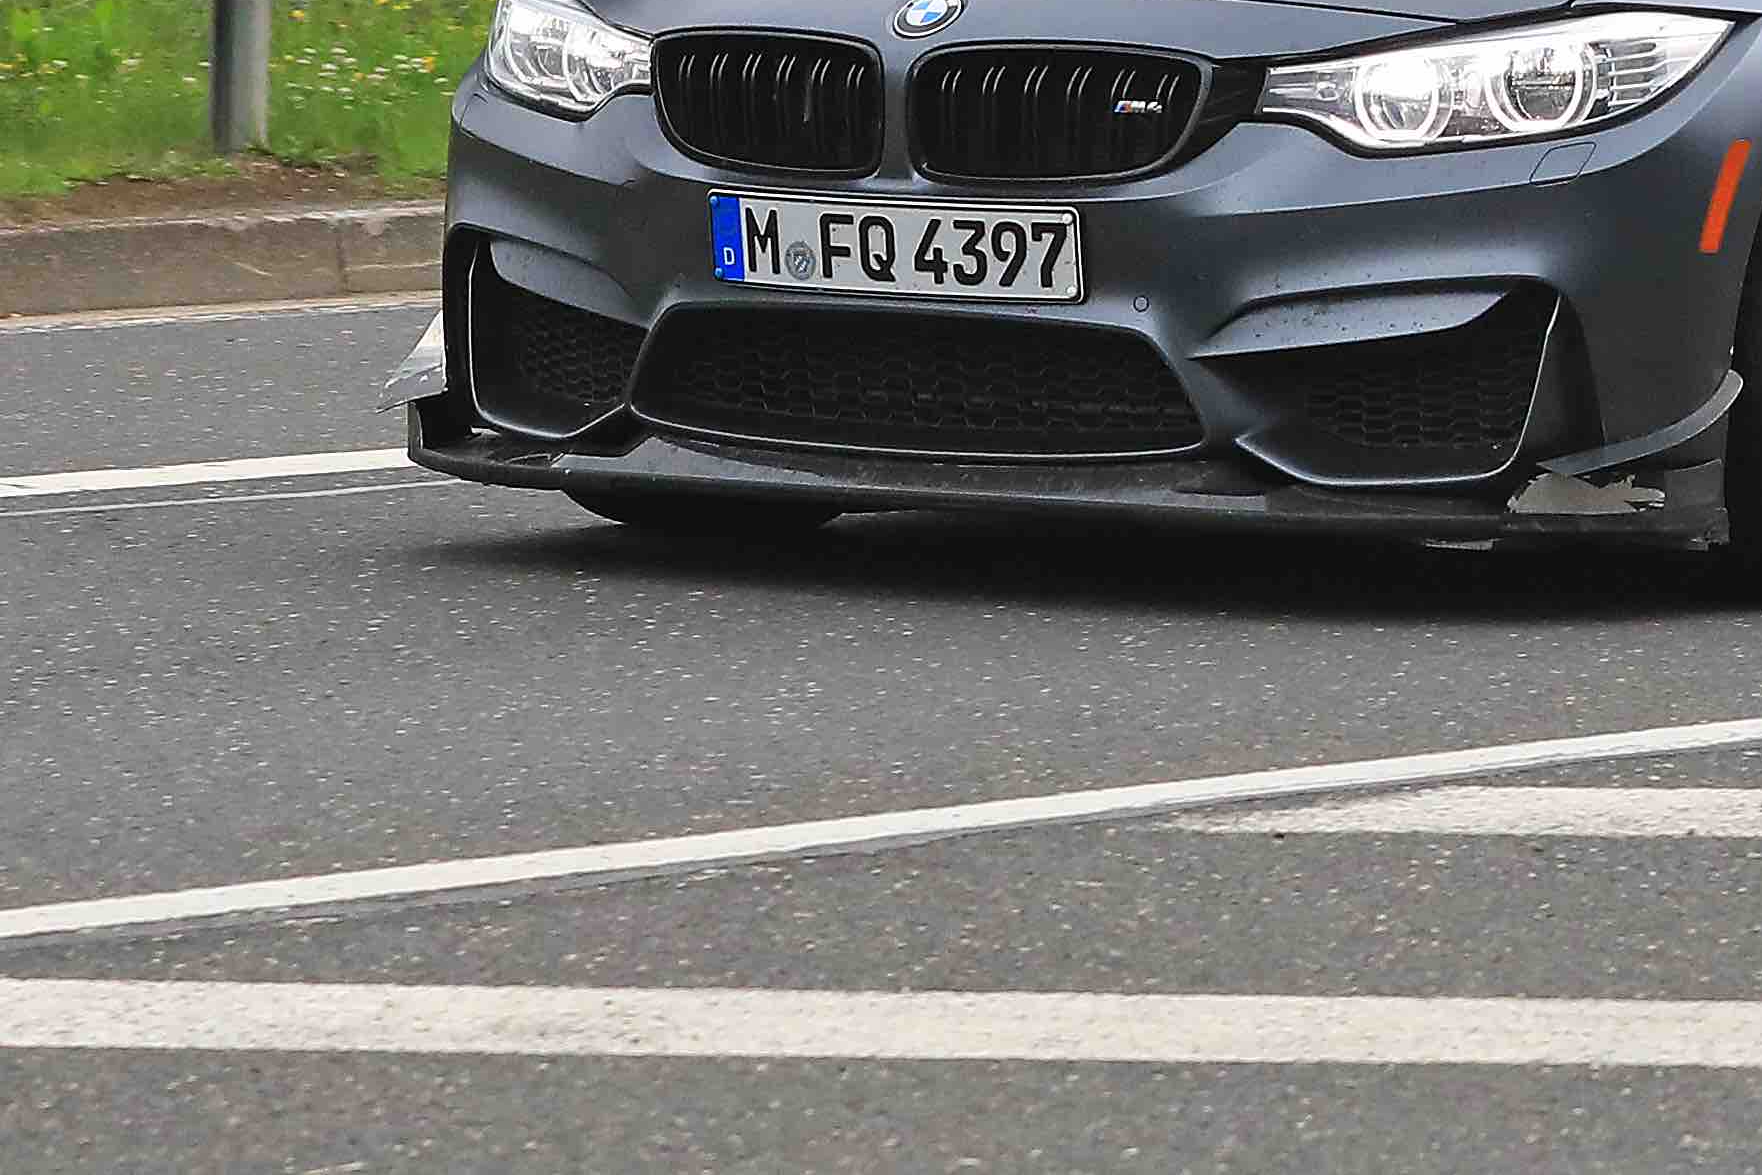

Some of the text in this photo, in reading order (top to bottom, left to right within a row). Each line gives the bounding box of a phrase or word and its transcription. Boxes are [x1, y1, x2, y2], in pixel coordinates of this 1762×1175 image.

[724, 247, 735, 265] D
[745, 207, 1067, 288] M FQ 4397
